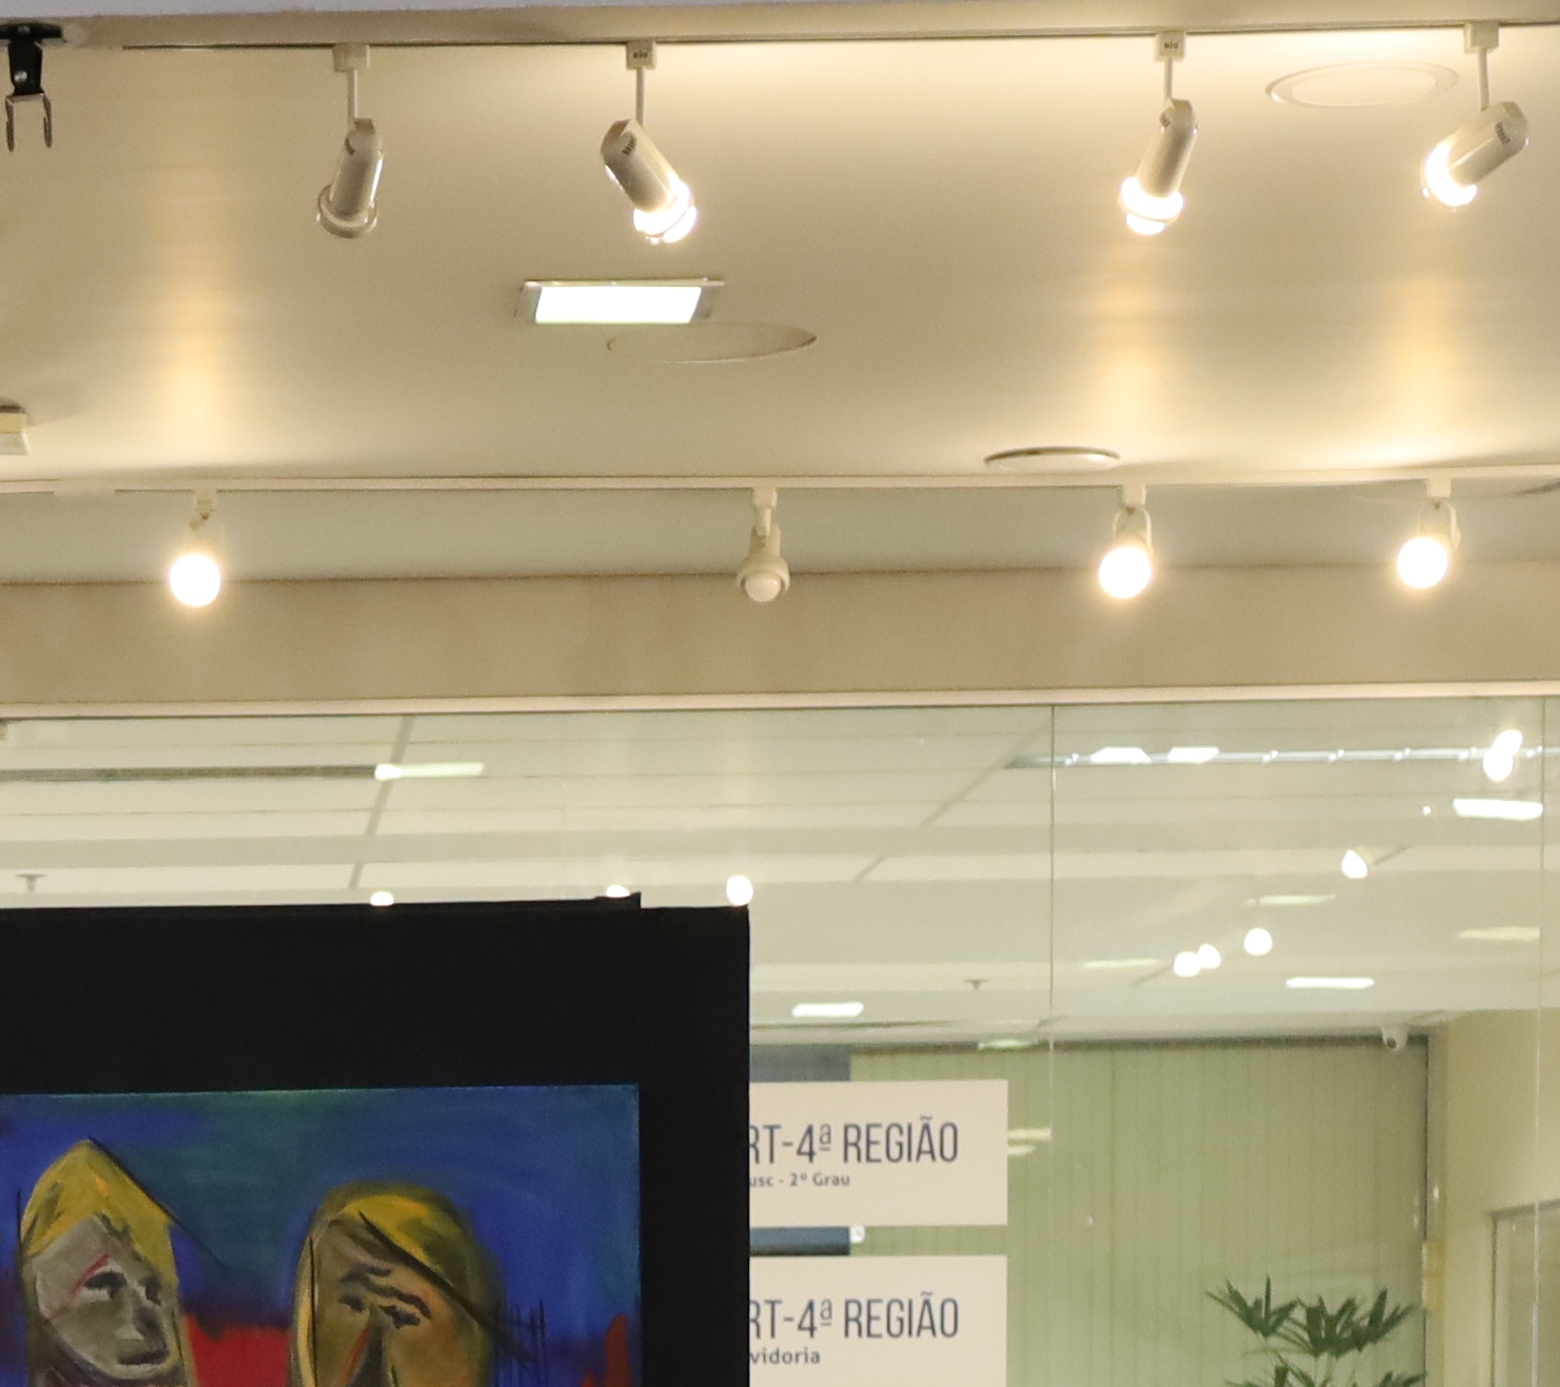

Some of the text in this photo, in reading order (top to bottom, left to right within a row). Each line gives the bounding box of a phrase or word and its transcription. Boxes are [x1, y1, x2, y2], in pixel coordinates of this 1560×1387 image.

[843, 1115, 958, 1163] REGIÃO
[812, 1172, 851, 1187] Grau
[844, 1291, 959, 1338] REGIÃO
